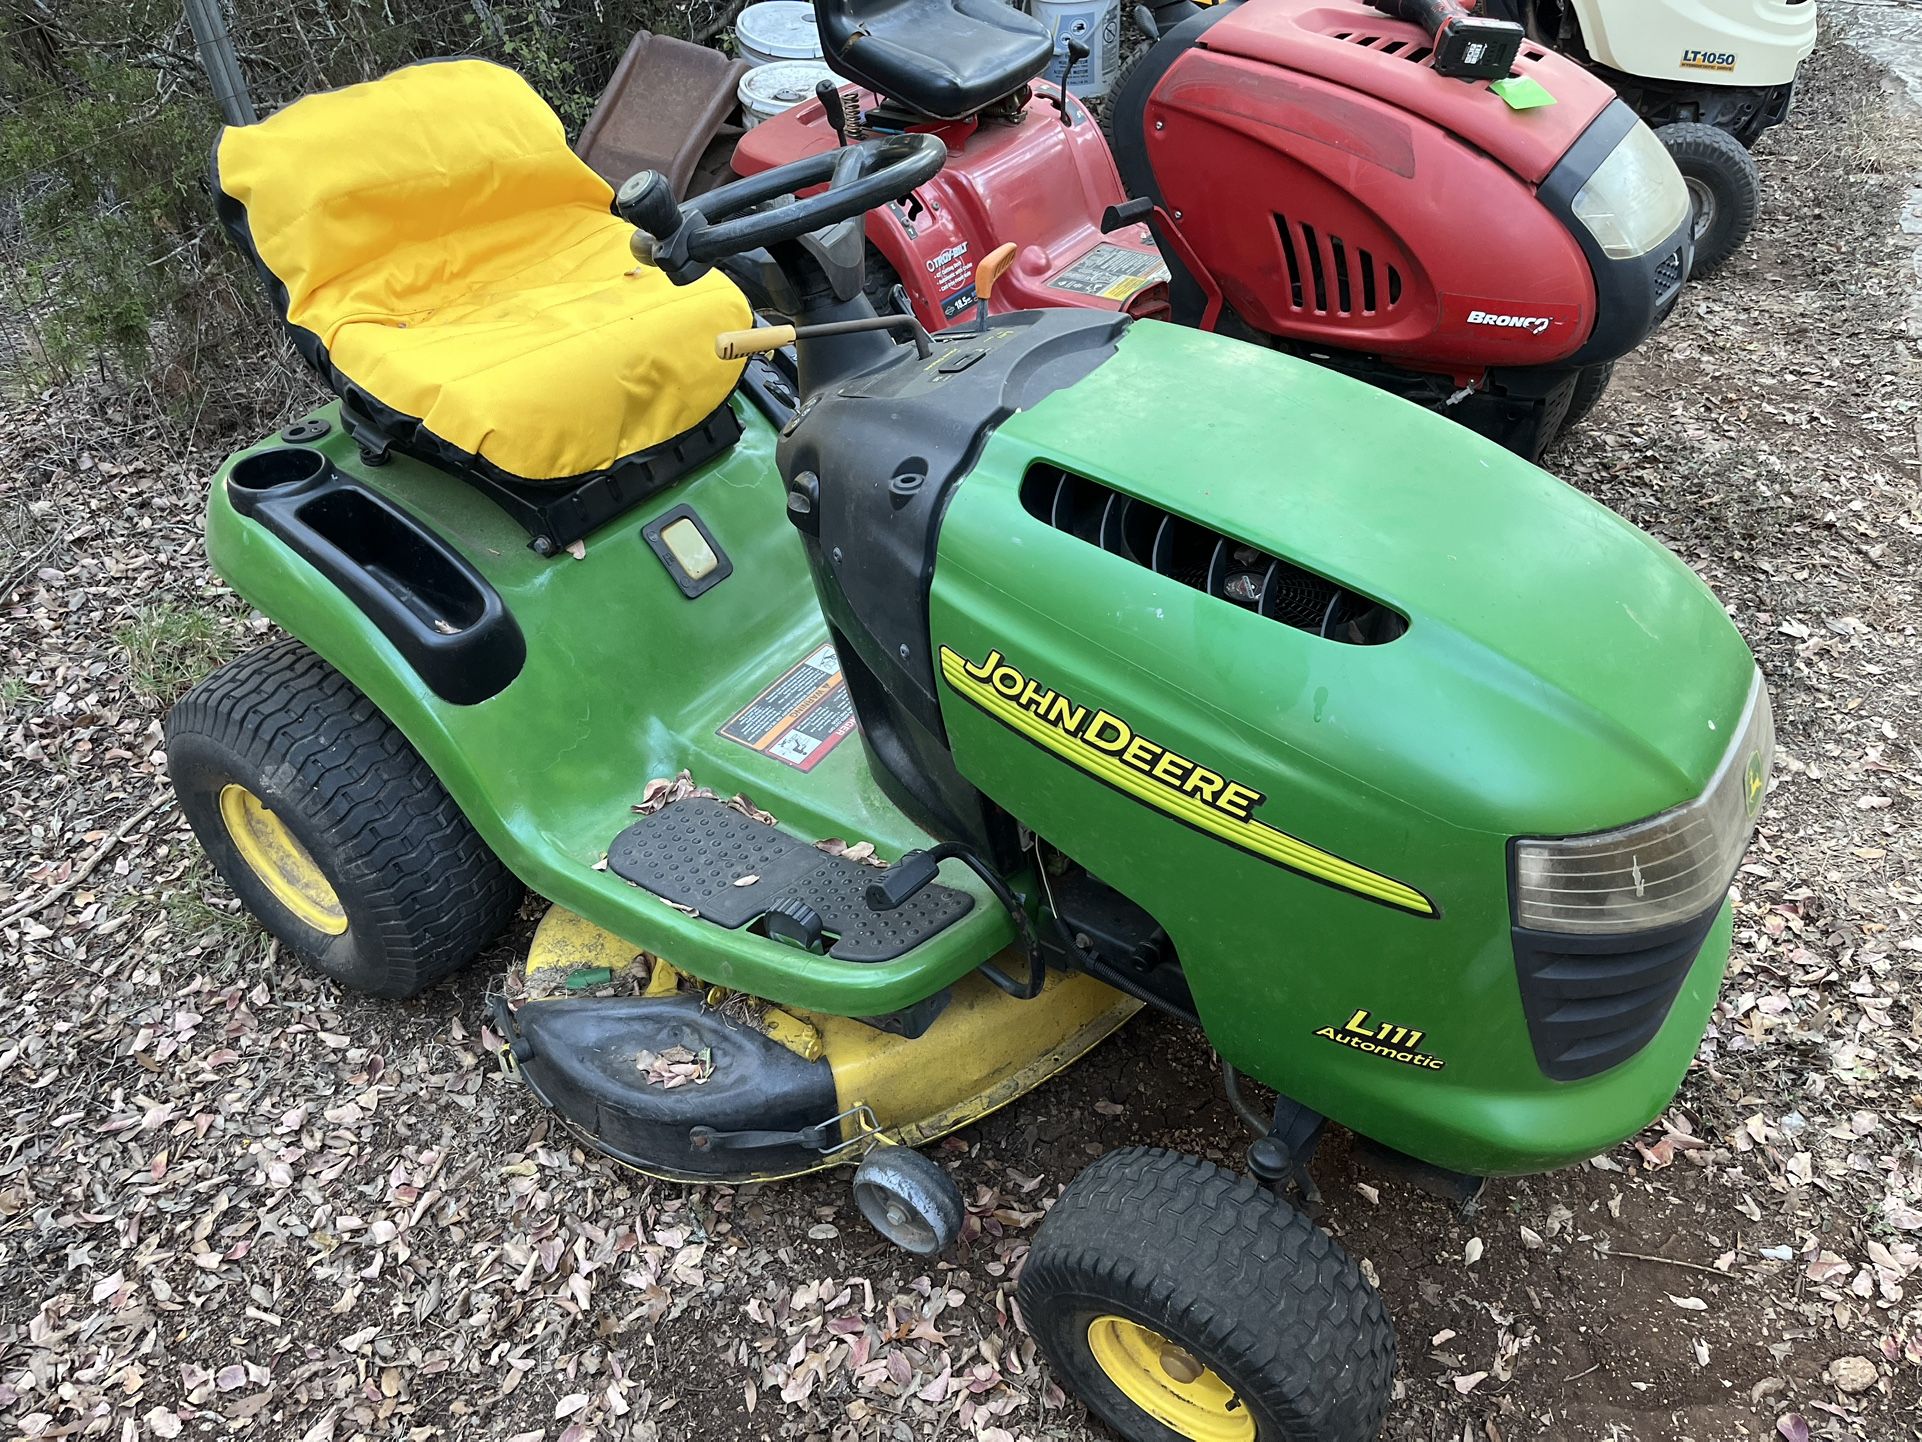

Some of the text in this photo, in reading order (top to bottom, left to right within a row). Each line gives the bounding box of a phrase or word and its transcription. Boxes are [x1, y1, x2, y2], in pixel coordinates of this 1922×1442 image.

[1683, 50, 1735, 65] LT1050
[1467, 311, 1549, 334] BRONCO
[789, 689, 825, 718] WARNING
[963, 650, 1088, 734] JOHN
[1083, 709, 1261, 820] DEERE
[1345, 1010, 1423, 1048] L111
[1316, 1027, 1444, 1069] Automatic
